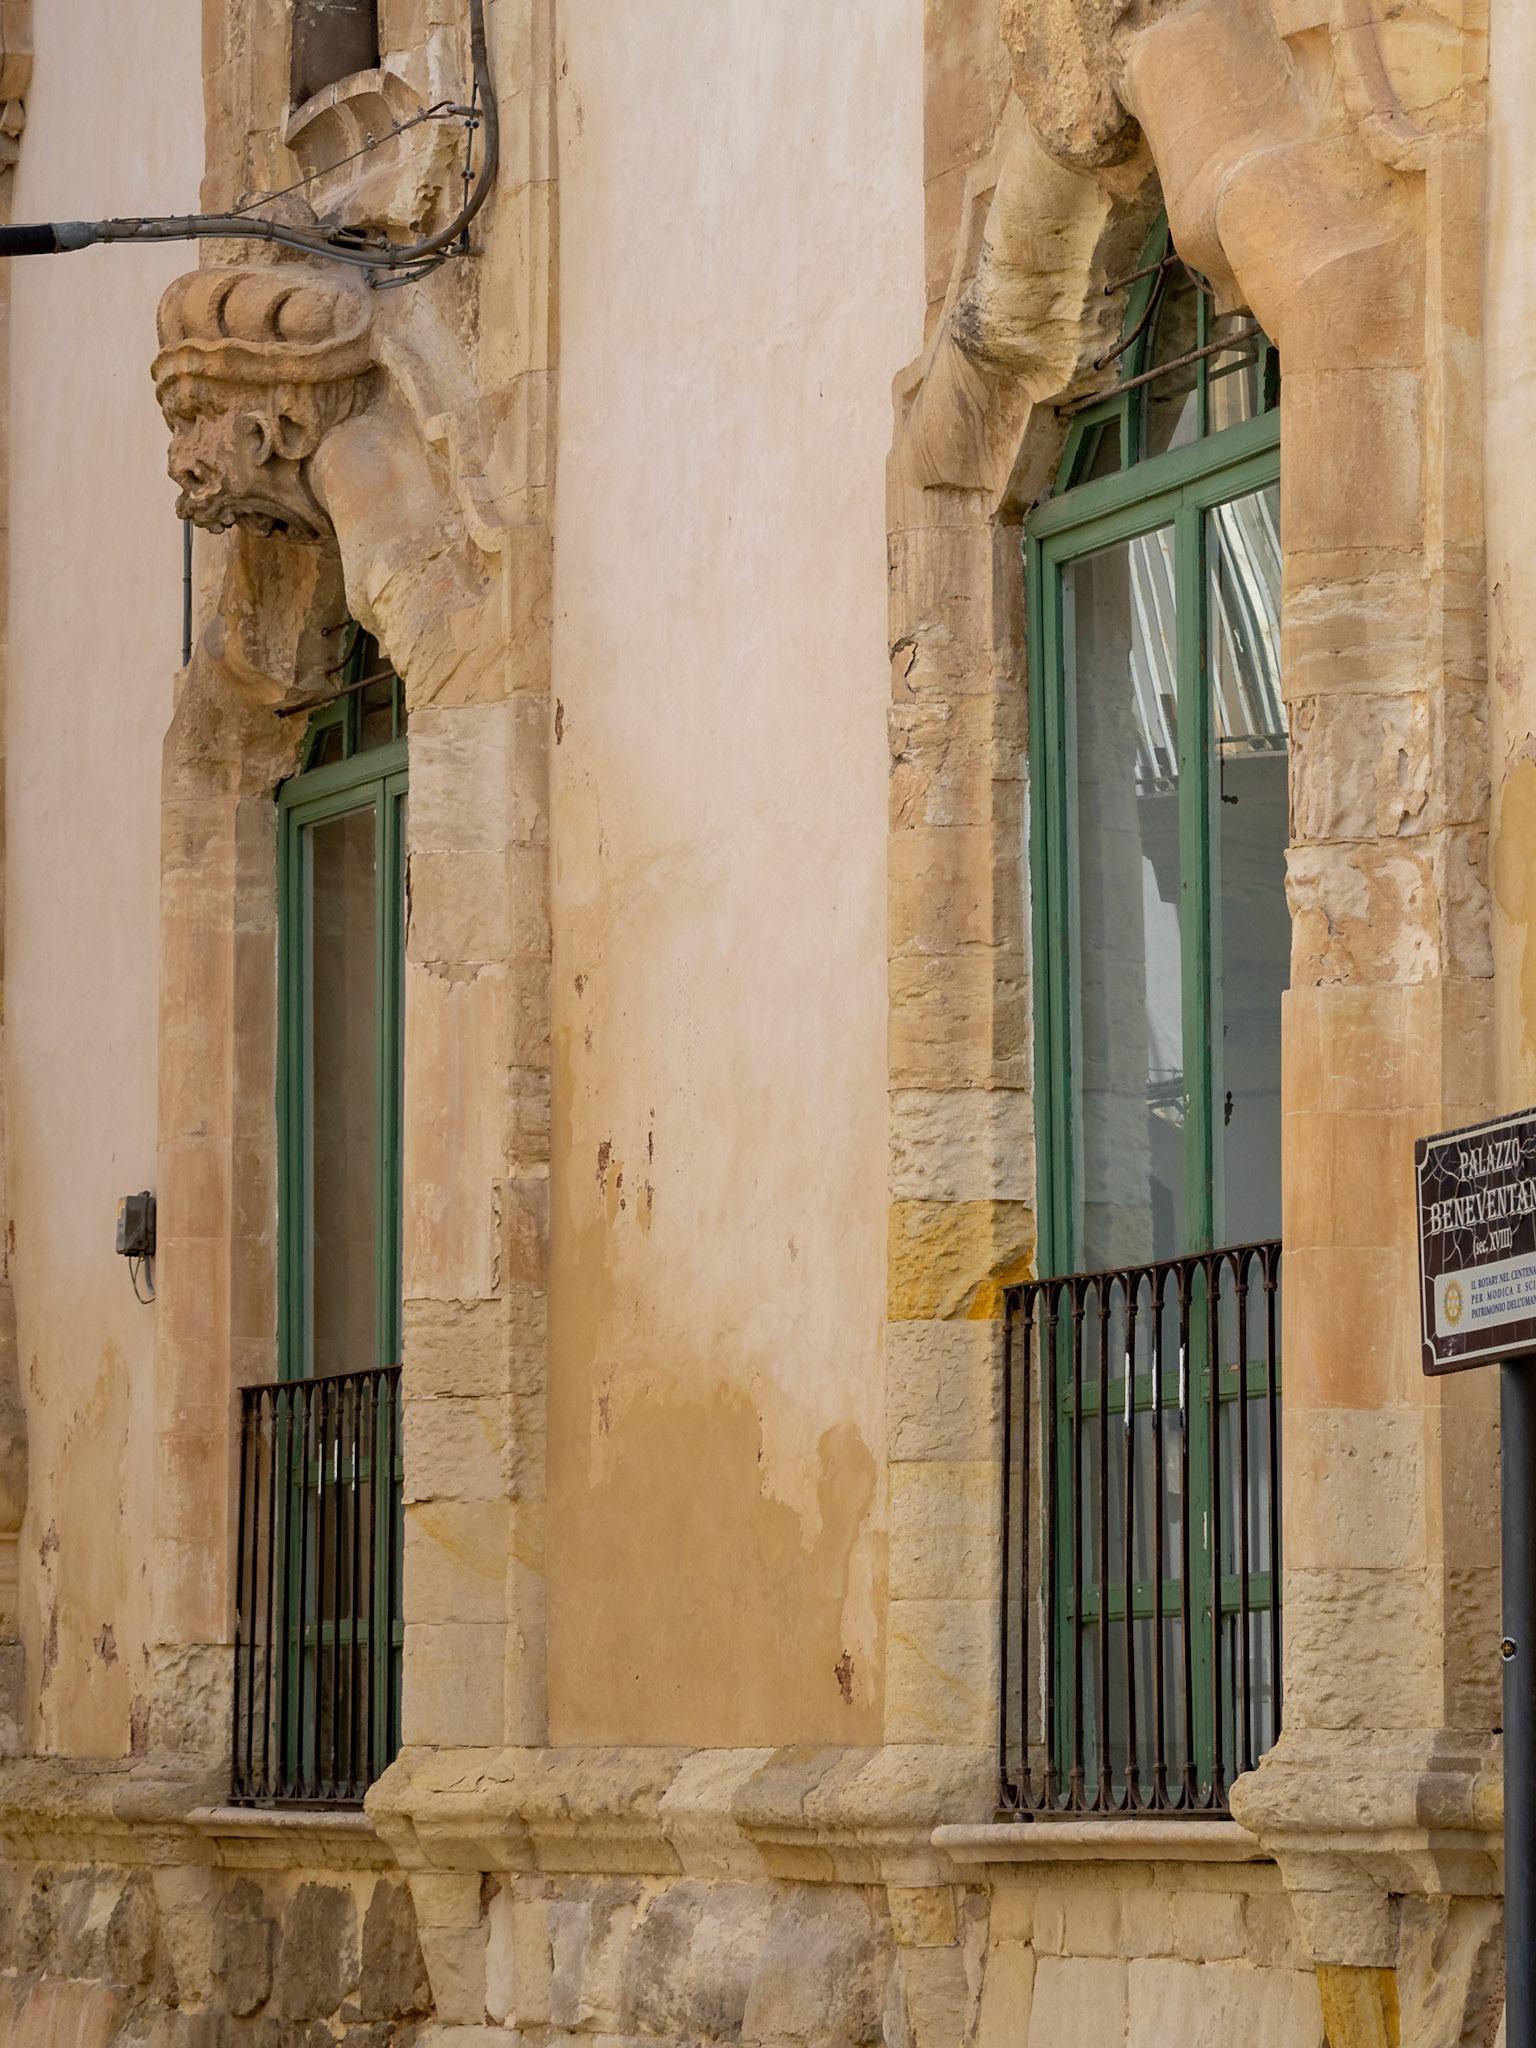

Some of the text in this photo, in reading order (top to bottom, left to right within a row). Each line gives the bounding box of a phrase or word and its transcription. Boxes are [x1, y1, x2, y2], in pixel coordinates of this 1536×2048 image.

[1459, 1138, 1520, 1181] PALAZZO
[1473, 1227, 1512, 1257] (sec. XVIII)
[1471, 1280, 1477, 1290] IL
[1478, 1274, 1498, 1288] ROTARY
[1499, 1272, 1510, 1283] NEL
[1471, 1293, 1483, 1304] PER
[1487, 1286, 1513, 1300] MODICA
[1517, 1283, 1522, 1293] E
[1471, 1302, 1505, 1318] PATRIMONIO
